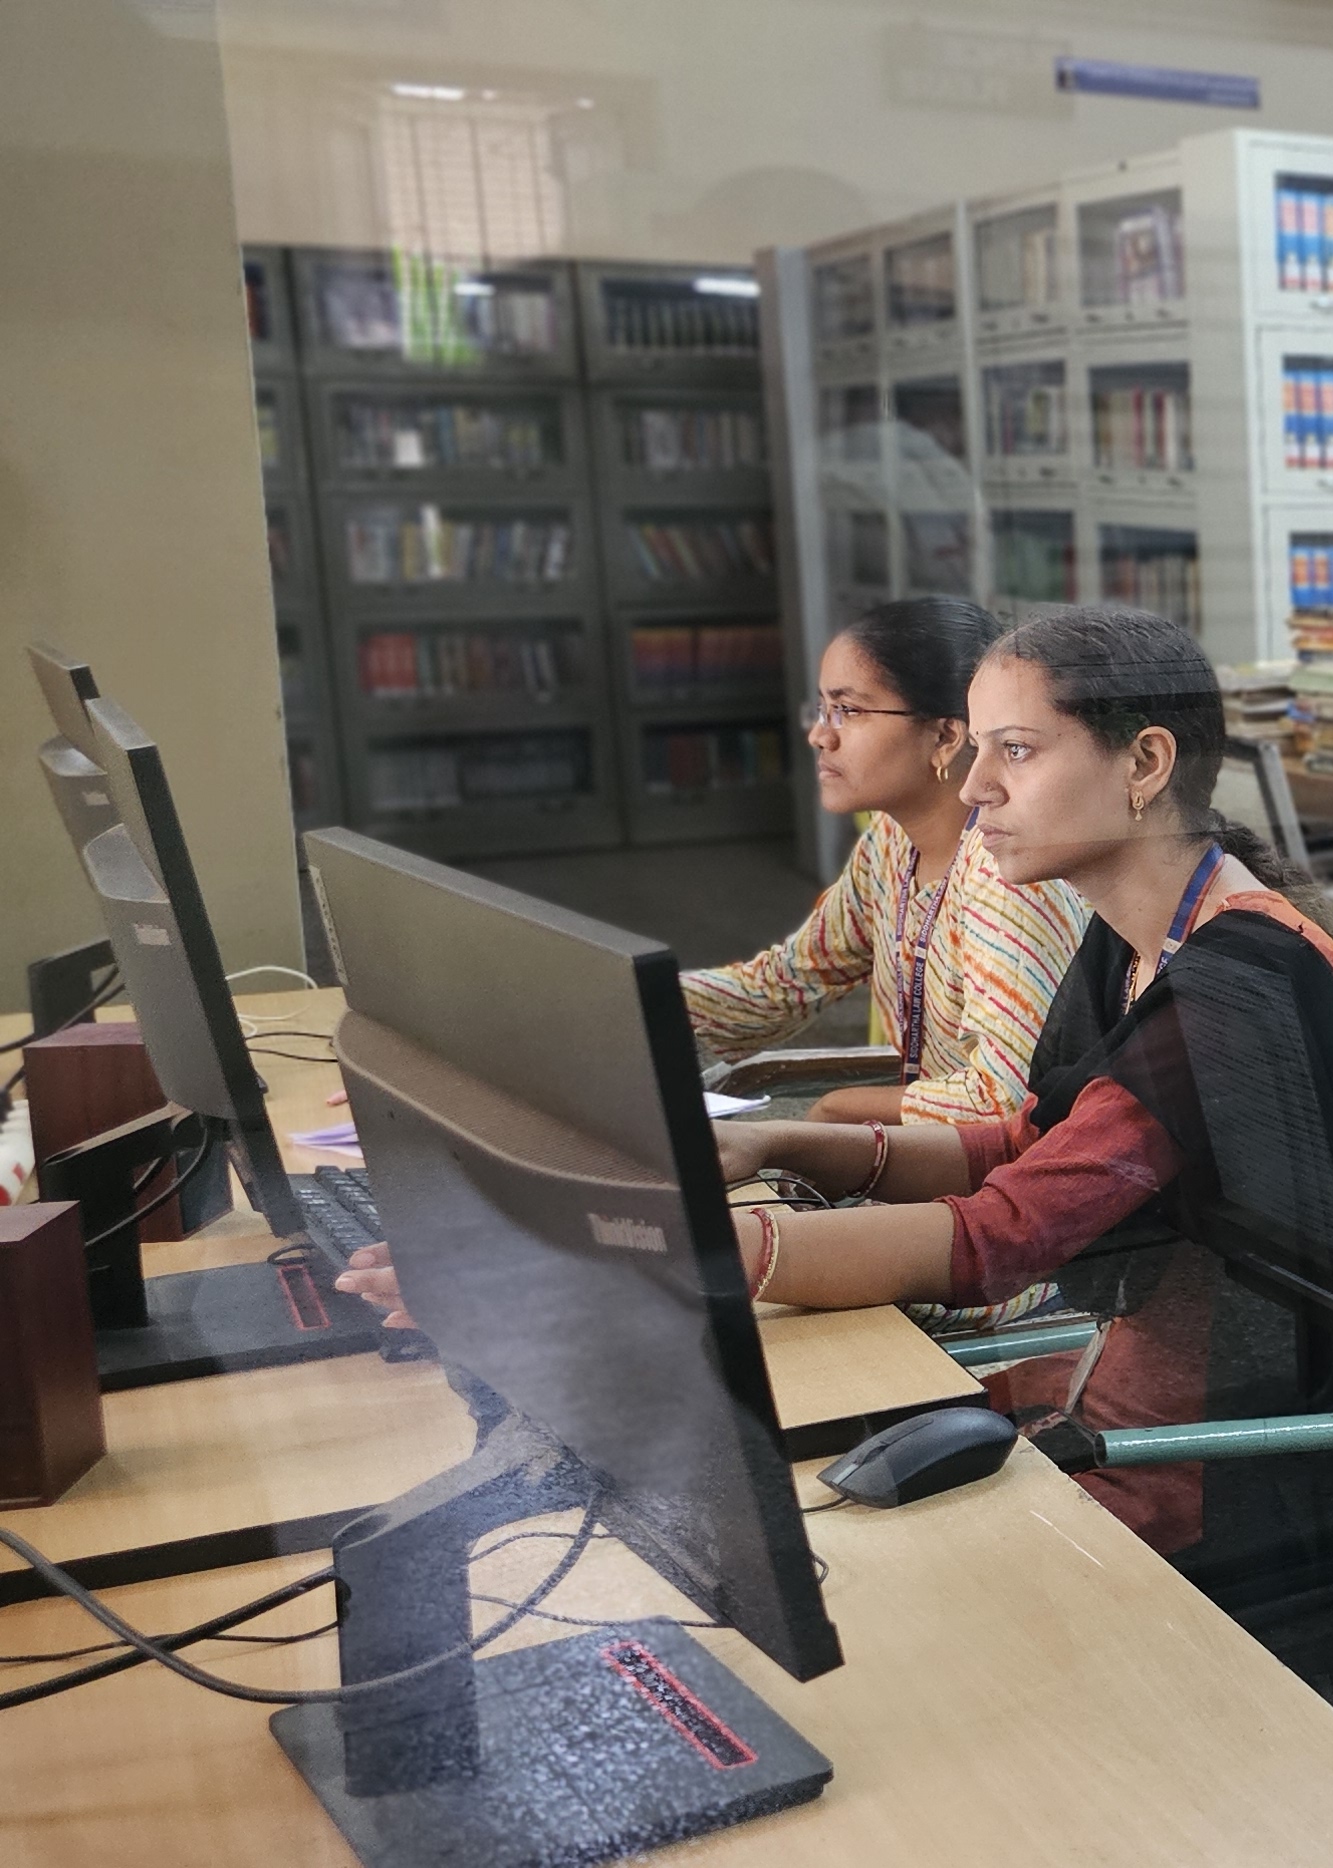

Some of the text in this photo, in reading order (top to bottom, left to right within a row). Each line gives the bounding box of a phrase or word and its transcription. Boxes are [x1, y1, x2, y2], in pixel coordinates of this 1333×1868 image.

[920, 895, 940, 942] SIDDHARTHA
[909, 961, 925, 1058] SIDDHARTHA LAW COLLEGE
